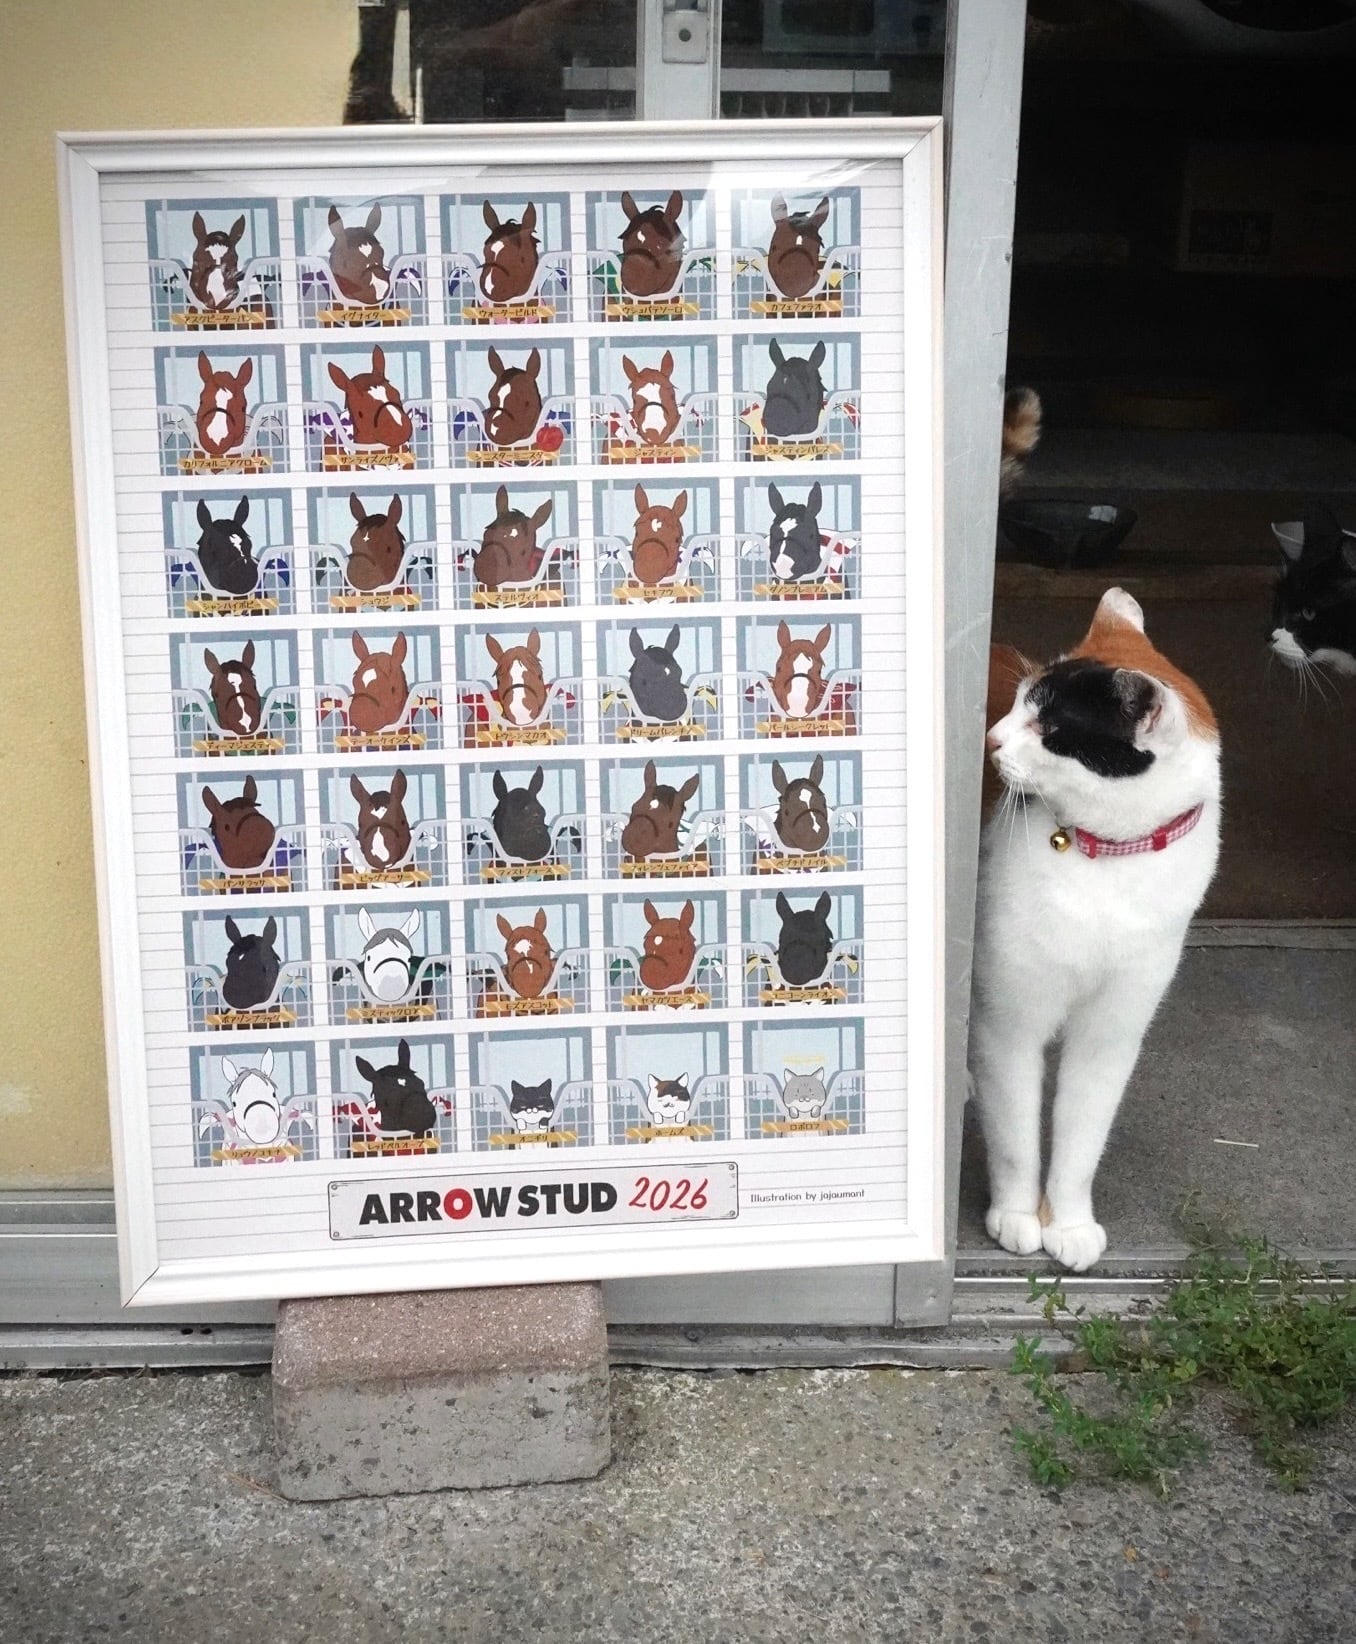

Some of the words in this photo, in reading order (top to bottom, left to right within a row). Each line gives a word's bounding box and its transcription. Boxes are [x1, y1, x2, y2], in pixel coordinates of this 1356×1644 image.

[771, 303, 822, 311] カフェファラオ
[342, 311, 386, 320] イグナイター
[183, 459, 267, 468] カリフォルニアクローム
[495, 593, 539, 601] ステルヴィオ
[495, 732, 547, 741] トウシンマカオ
[498, 868, 553, 876] ファストフォース
[519, 1134, 548, 1143] オニギリ
[359, 1186, 512, 1225] ARROW
[517, 1182, 617, 1217] STUD
[628, 1176, 709, 1211] 2026
[750, 1193, 801, 1203] Illustration
[805, 1192, 816, 1201] by
